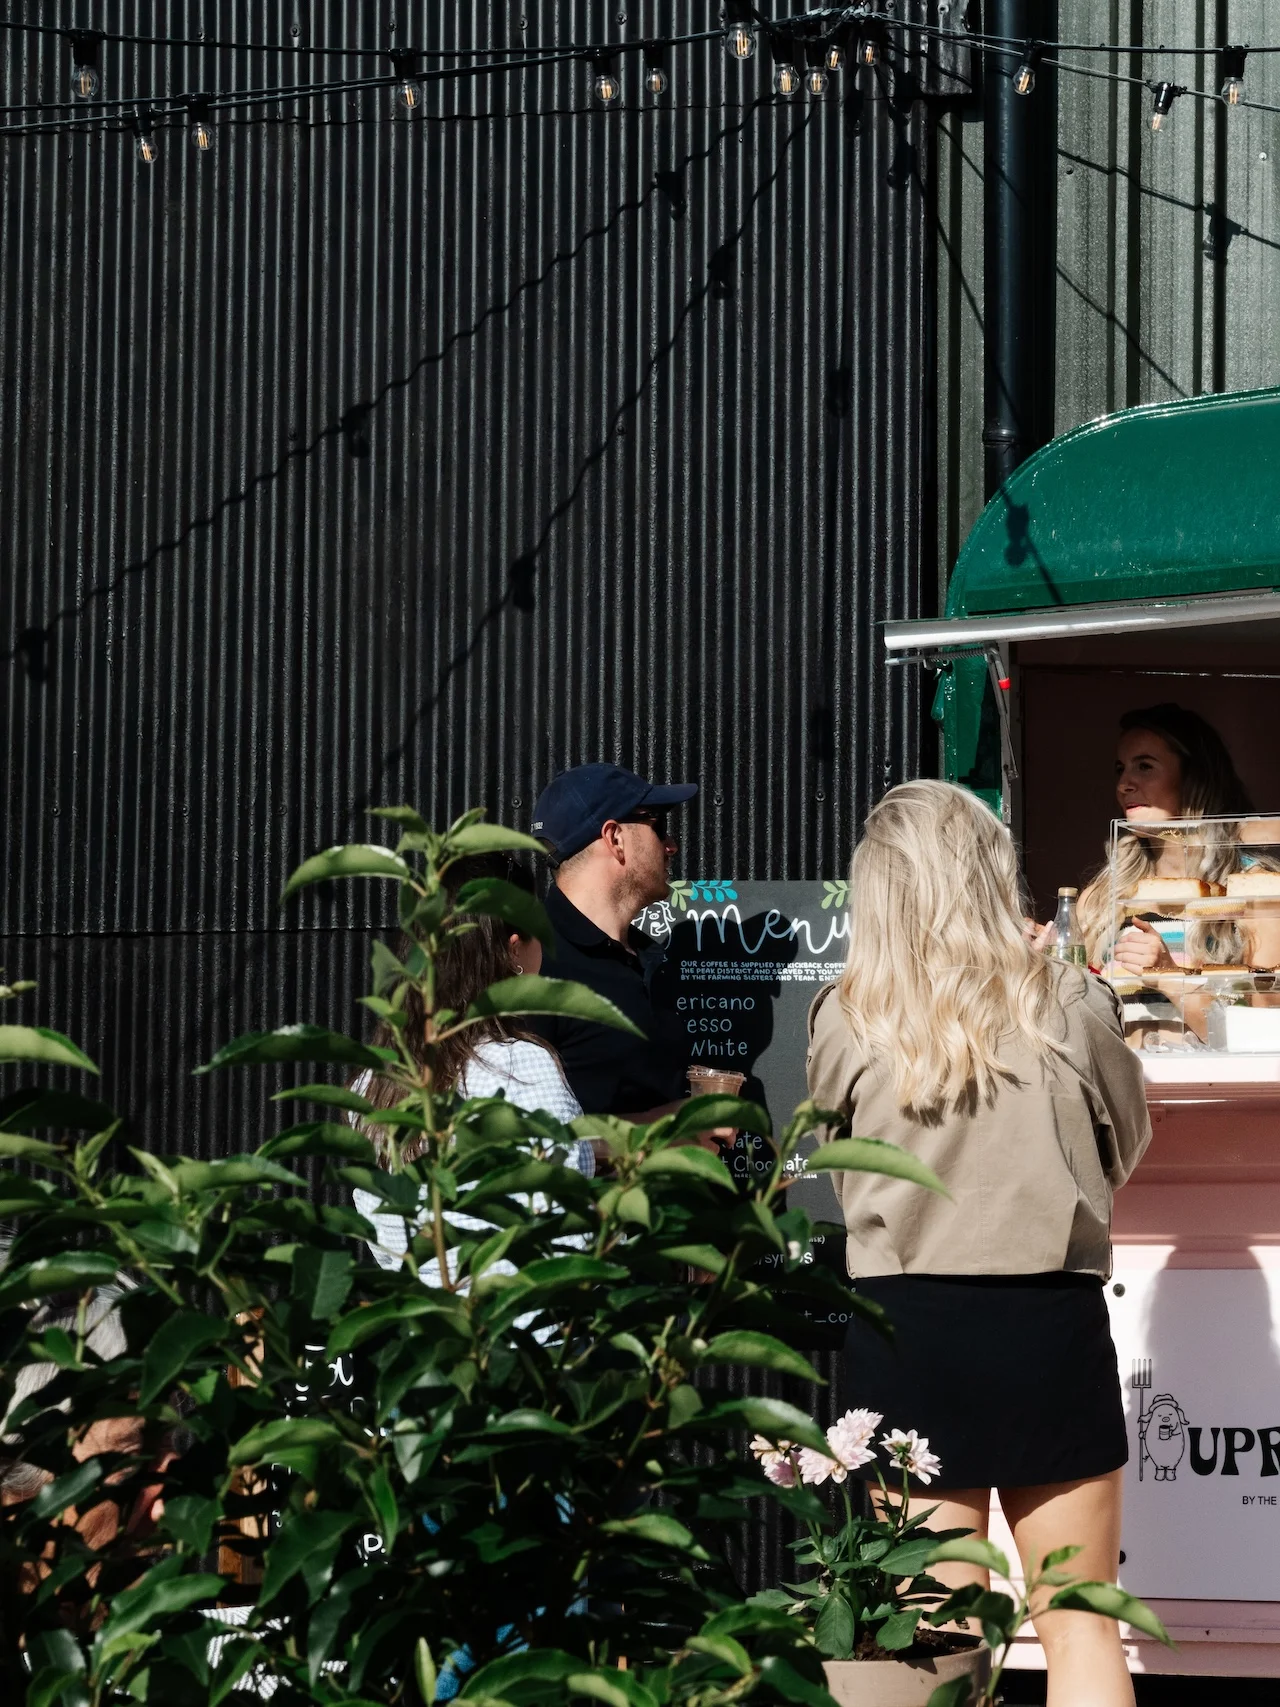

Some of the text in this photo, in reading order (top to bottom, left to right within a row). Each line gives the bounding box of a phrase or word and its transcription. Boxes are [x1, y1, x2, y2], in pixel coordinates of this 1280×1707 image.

[740, 961, 774, 969] SUPPLIED
[743, 974, 774, 982] SISTERS
[676, 993, 756, 1010] ericano
[686, 1018, 733, 1034] esso
[1242, 1496, 1256, 1505] BY
[1257, 1496, 1277, 1506] THE
